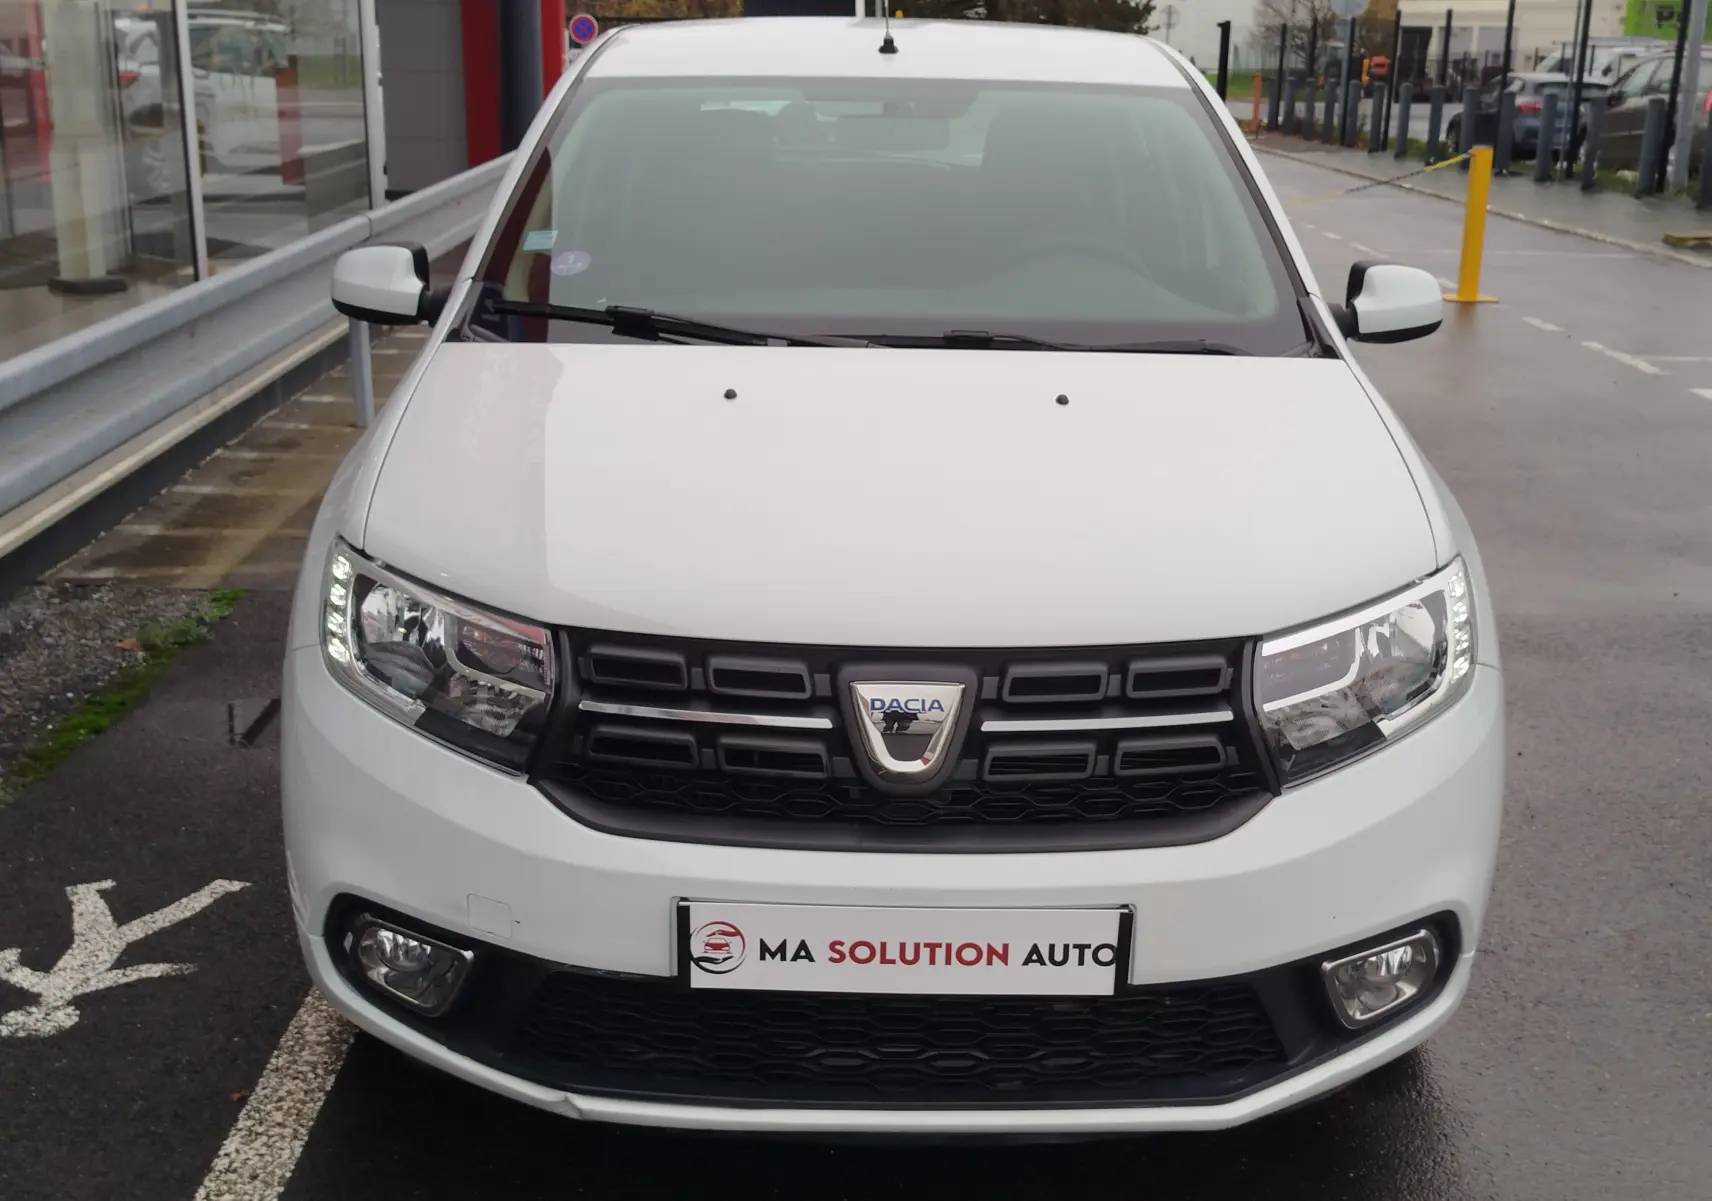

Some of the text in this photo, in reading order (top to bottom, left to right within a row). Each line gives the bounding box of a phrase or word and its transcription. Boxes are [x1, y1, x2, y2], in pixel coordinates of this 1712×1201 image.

[870, 698, 944, 712] DACIA
[759, 938, 1117, 967] MA SOLUTION AUTO
